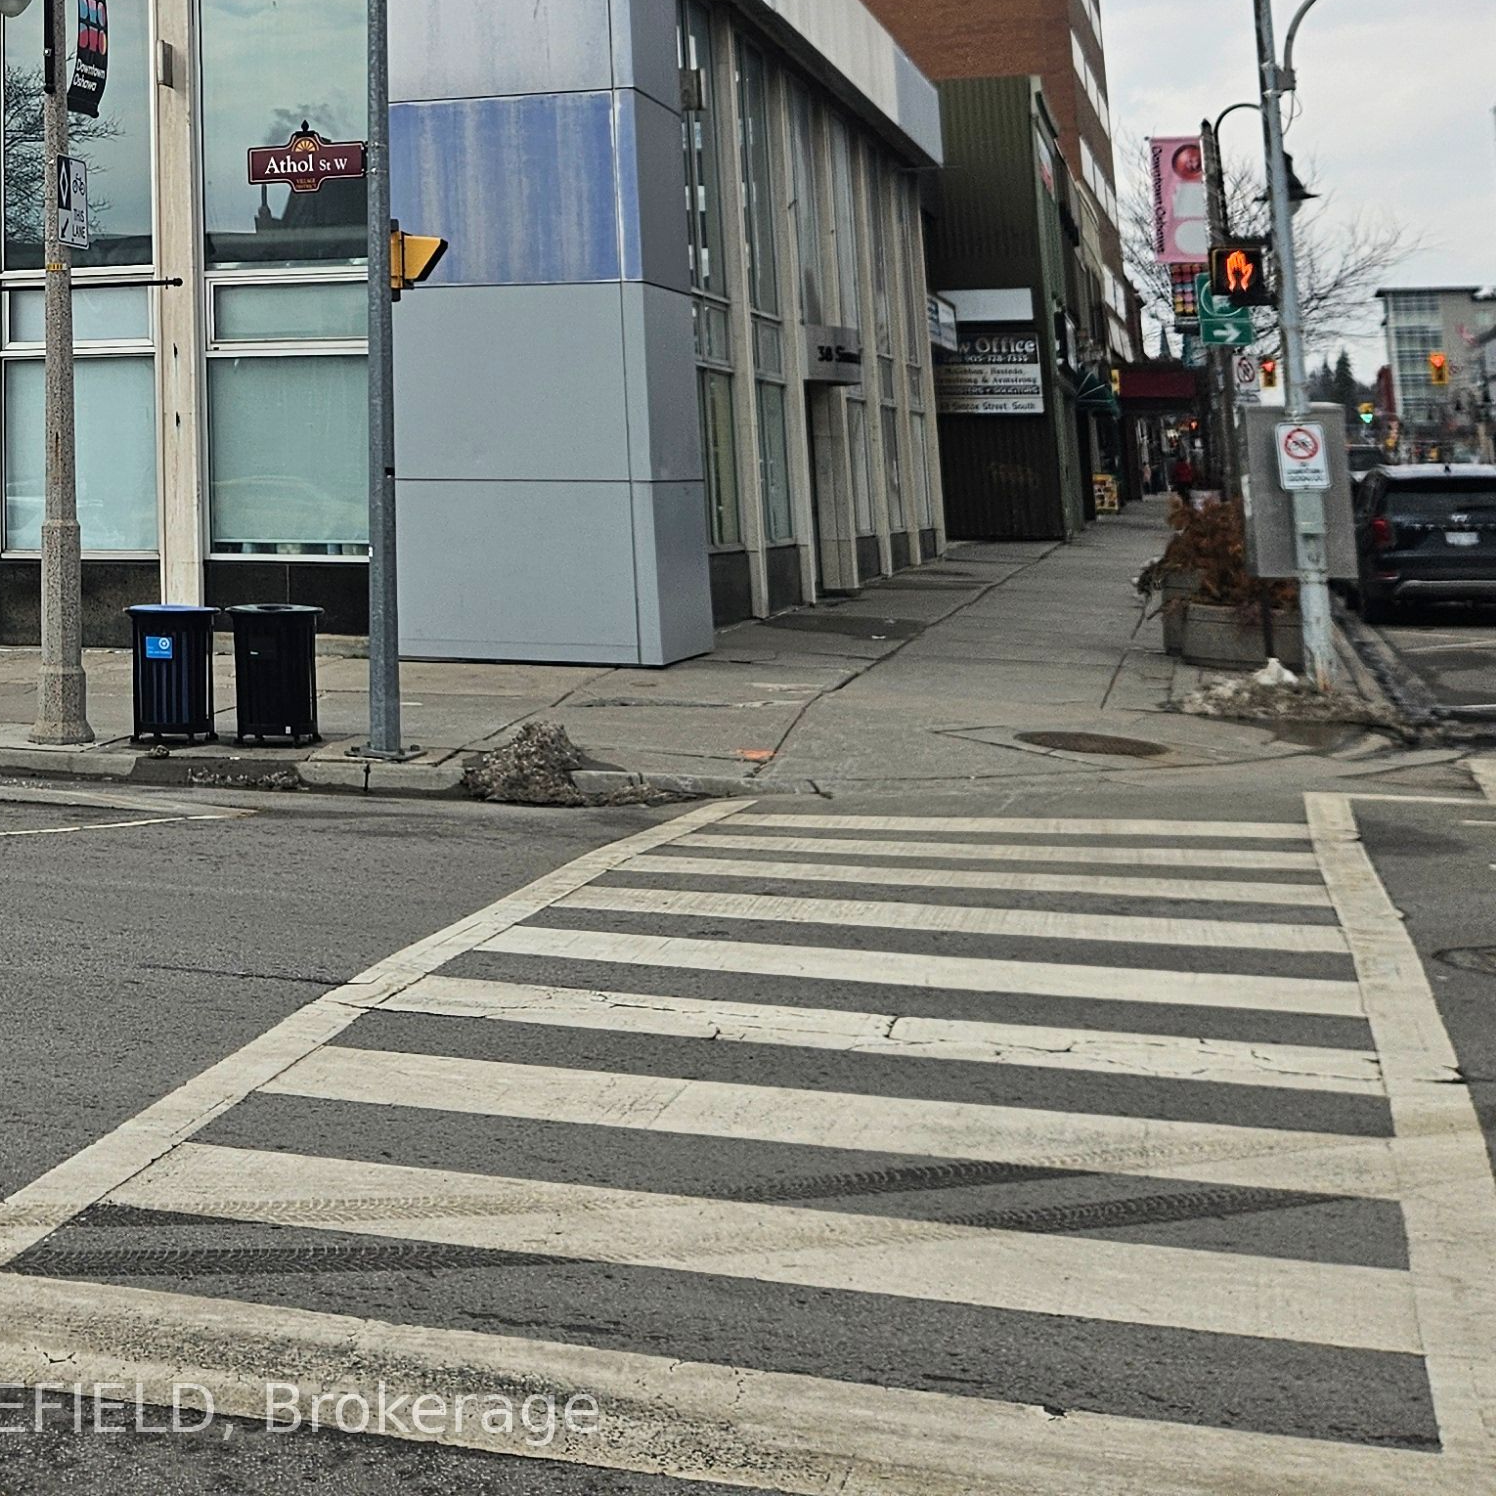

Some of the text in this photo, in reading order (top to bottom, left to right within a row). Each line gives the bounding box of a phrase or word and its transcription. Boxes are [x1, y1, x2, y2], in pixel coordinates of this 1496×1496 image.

[76, 58, 106, 79] Downtown
[73, 73, 98, 91] Oshawa
[264, 153, 348, 175] Athol St W
[975, 337, 1035, 353] Office
